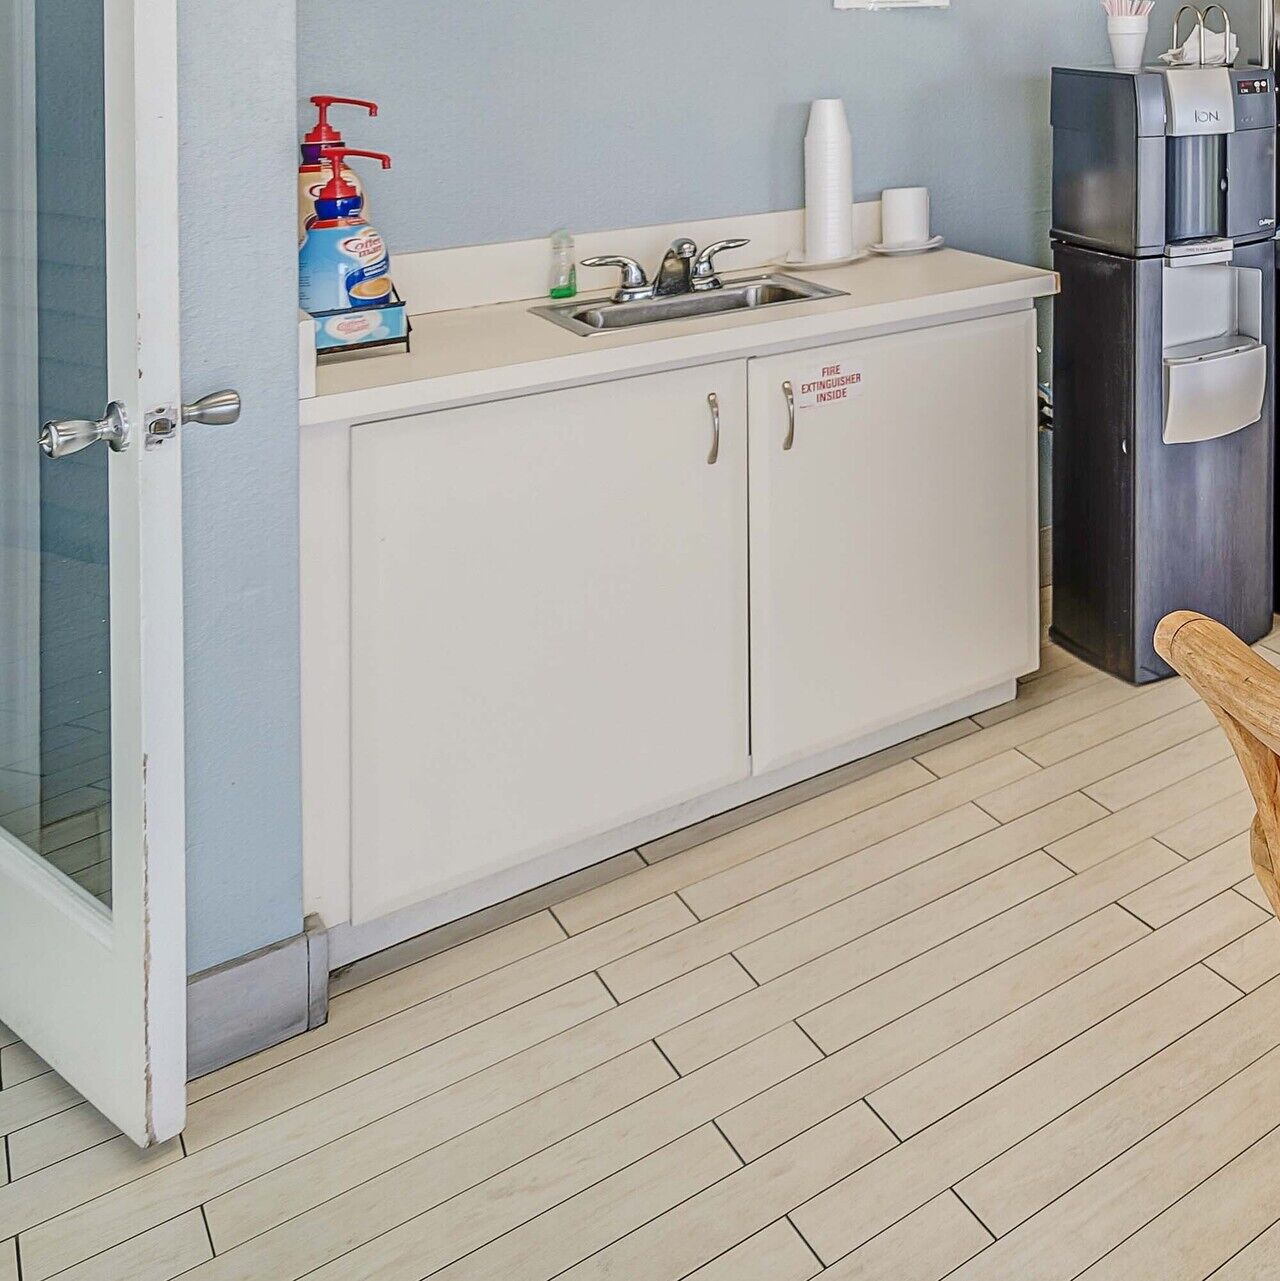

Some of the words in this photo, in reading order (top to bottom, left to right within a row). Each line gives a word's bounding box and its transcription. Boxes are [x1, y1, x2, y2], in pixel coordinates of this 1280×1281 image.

[1194, 109, 1220, 123] ION
[821, 364, 841, 378] FIRE
[801, 373, 862, 394] EXTINGUISHER
[816, 388, 848, 403] INSIDE
